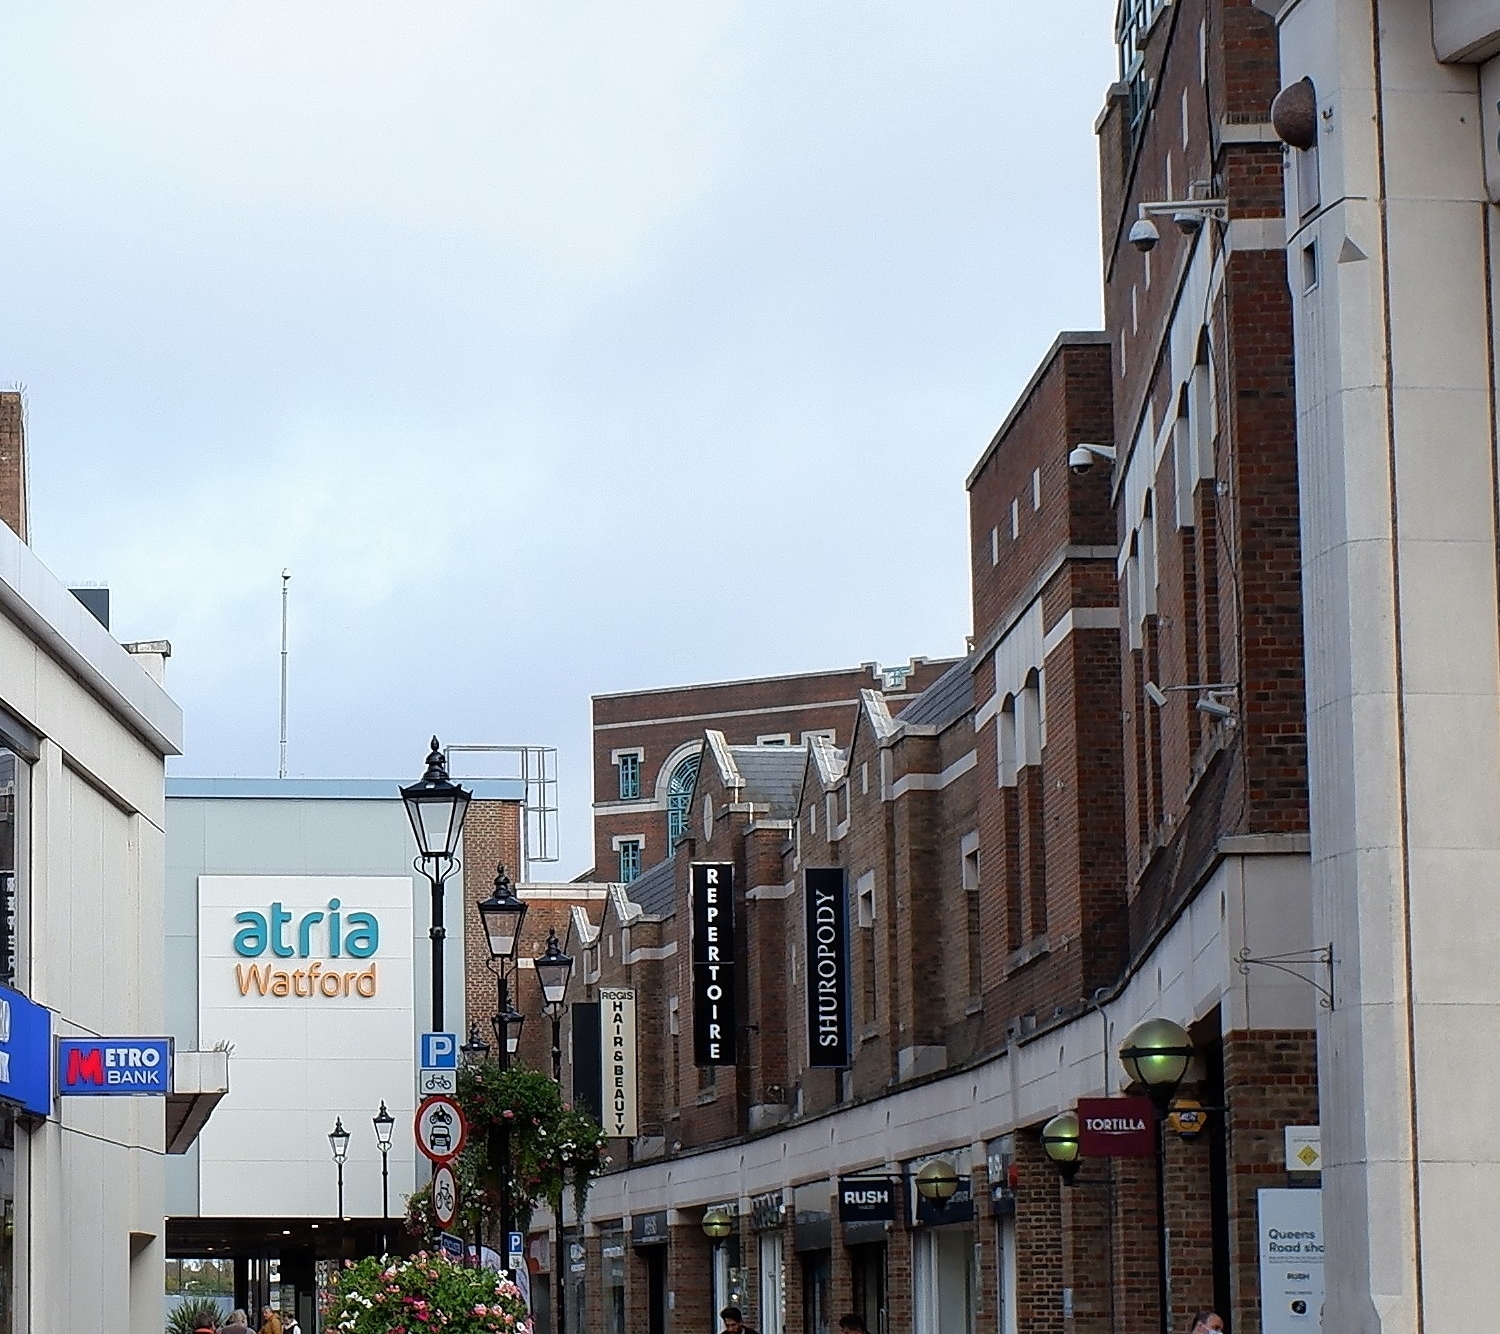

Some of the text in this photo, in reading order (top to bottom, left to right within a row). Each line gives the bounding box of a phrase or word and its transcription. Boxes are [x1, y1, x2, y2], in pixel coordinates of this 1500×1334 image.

[233, 897, 380, 959] atria
[235, 961, 379, 999] Watford
[706, 868, 723, 1059] REPERTOIRE
[815, 888, 839, 1047] SHUROPODY
[66, 1048, 161, 1086] METRO
[429, 1036, 453, 1067] P
[612, 1001, 626, 1136] HAIR & BEAUTY
[107, 1070, 160, 1085] BANK
[1085, 1118, 1147, 1131] TORTILLA
[844, 1190, 889, 1205] RUSH
[1268, 1228, 1316, 1240] Queens
[1269, 1242, 1301, 1253] Road
